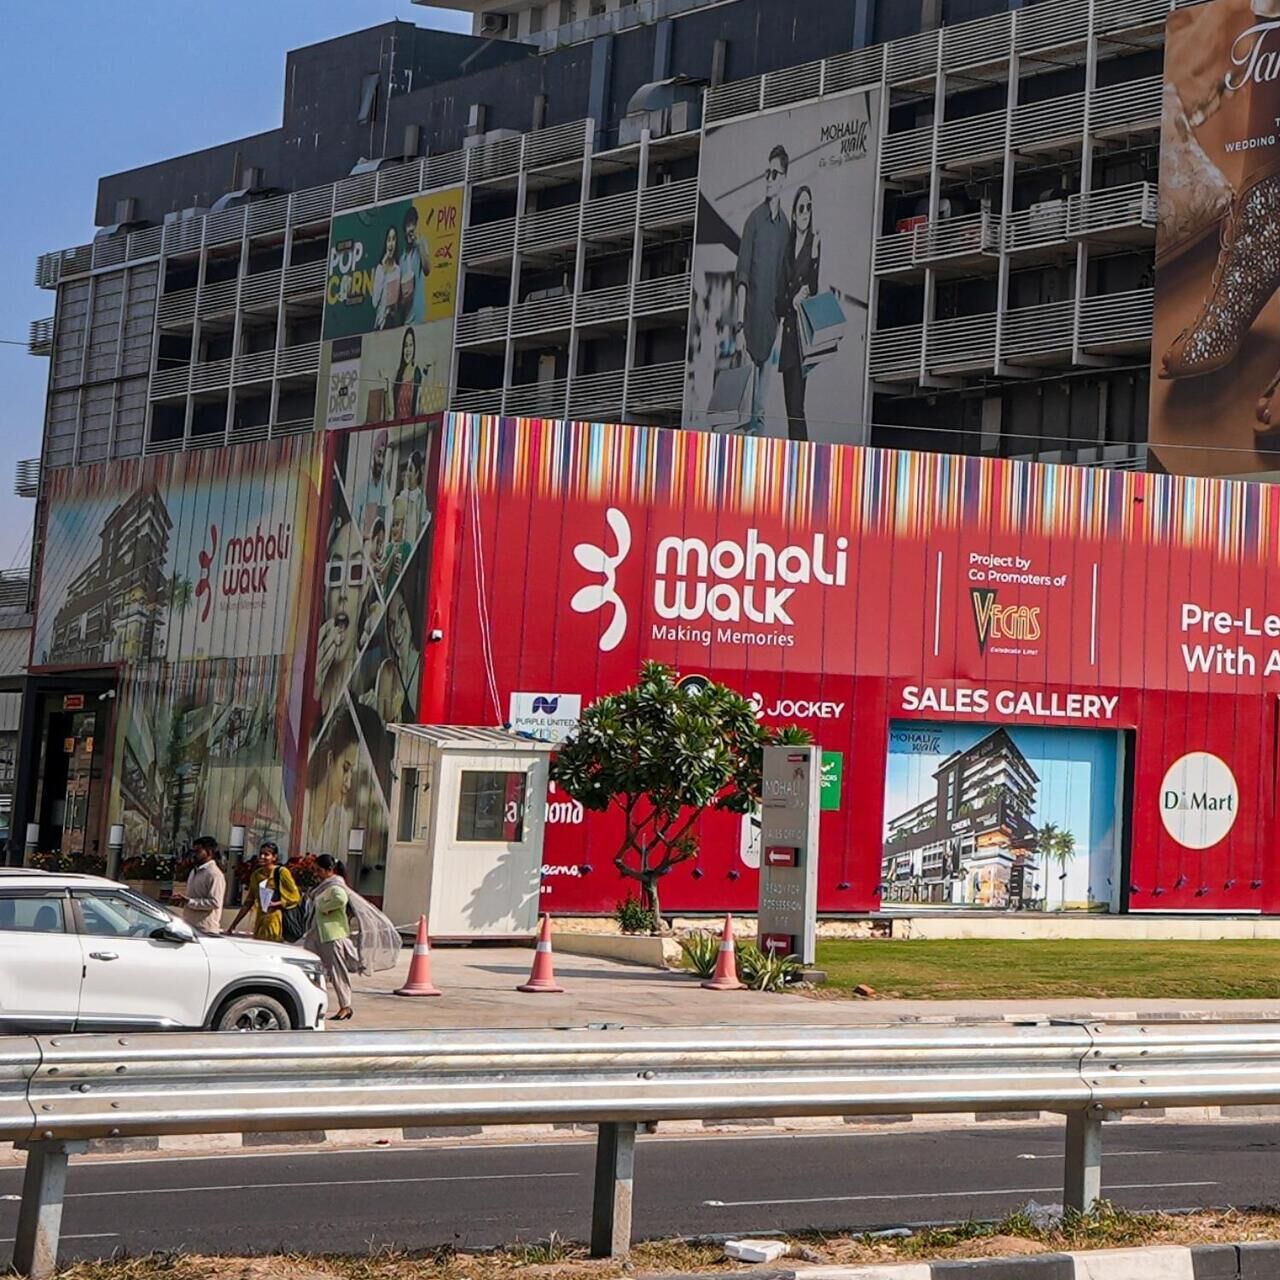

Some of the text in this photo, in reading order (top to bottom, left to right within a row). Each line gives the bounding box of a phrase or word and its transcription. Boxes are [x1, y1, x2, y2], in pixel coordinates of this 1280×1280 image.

[820, 119, 859, 141] MOHALI
[840, 121, 868, 154] walk
[1224, 135, 1276, 152] WEDDING
[436, 206, 457, 232] PVR
[329, 241, 364, 276] POP
[331, 369, 358, 391] SHOP
[329, 391, 357, 413] DROP
[225, 523, 291, 565] mohali
[655, 528, 849, 587] mohali
[969, 552, 1031, 571] Project by
[968, 568, 1067, 586] Co Promoters of
[972, 591, 1041, 642] VEGAS
[651, 624, 795, 647] Making Memories
[1181, 643, 1256, 676] With
[767, 699, 845, 719] JOCKEY
[902, 686, 1118, 720] SALES GALLERY
[515, 718, 576, 727] PURPLE UNITED
[889, 733, 931, 744] MOHALI
[911, 737, 941, 754] walk
